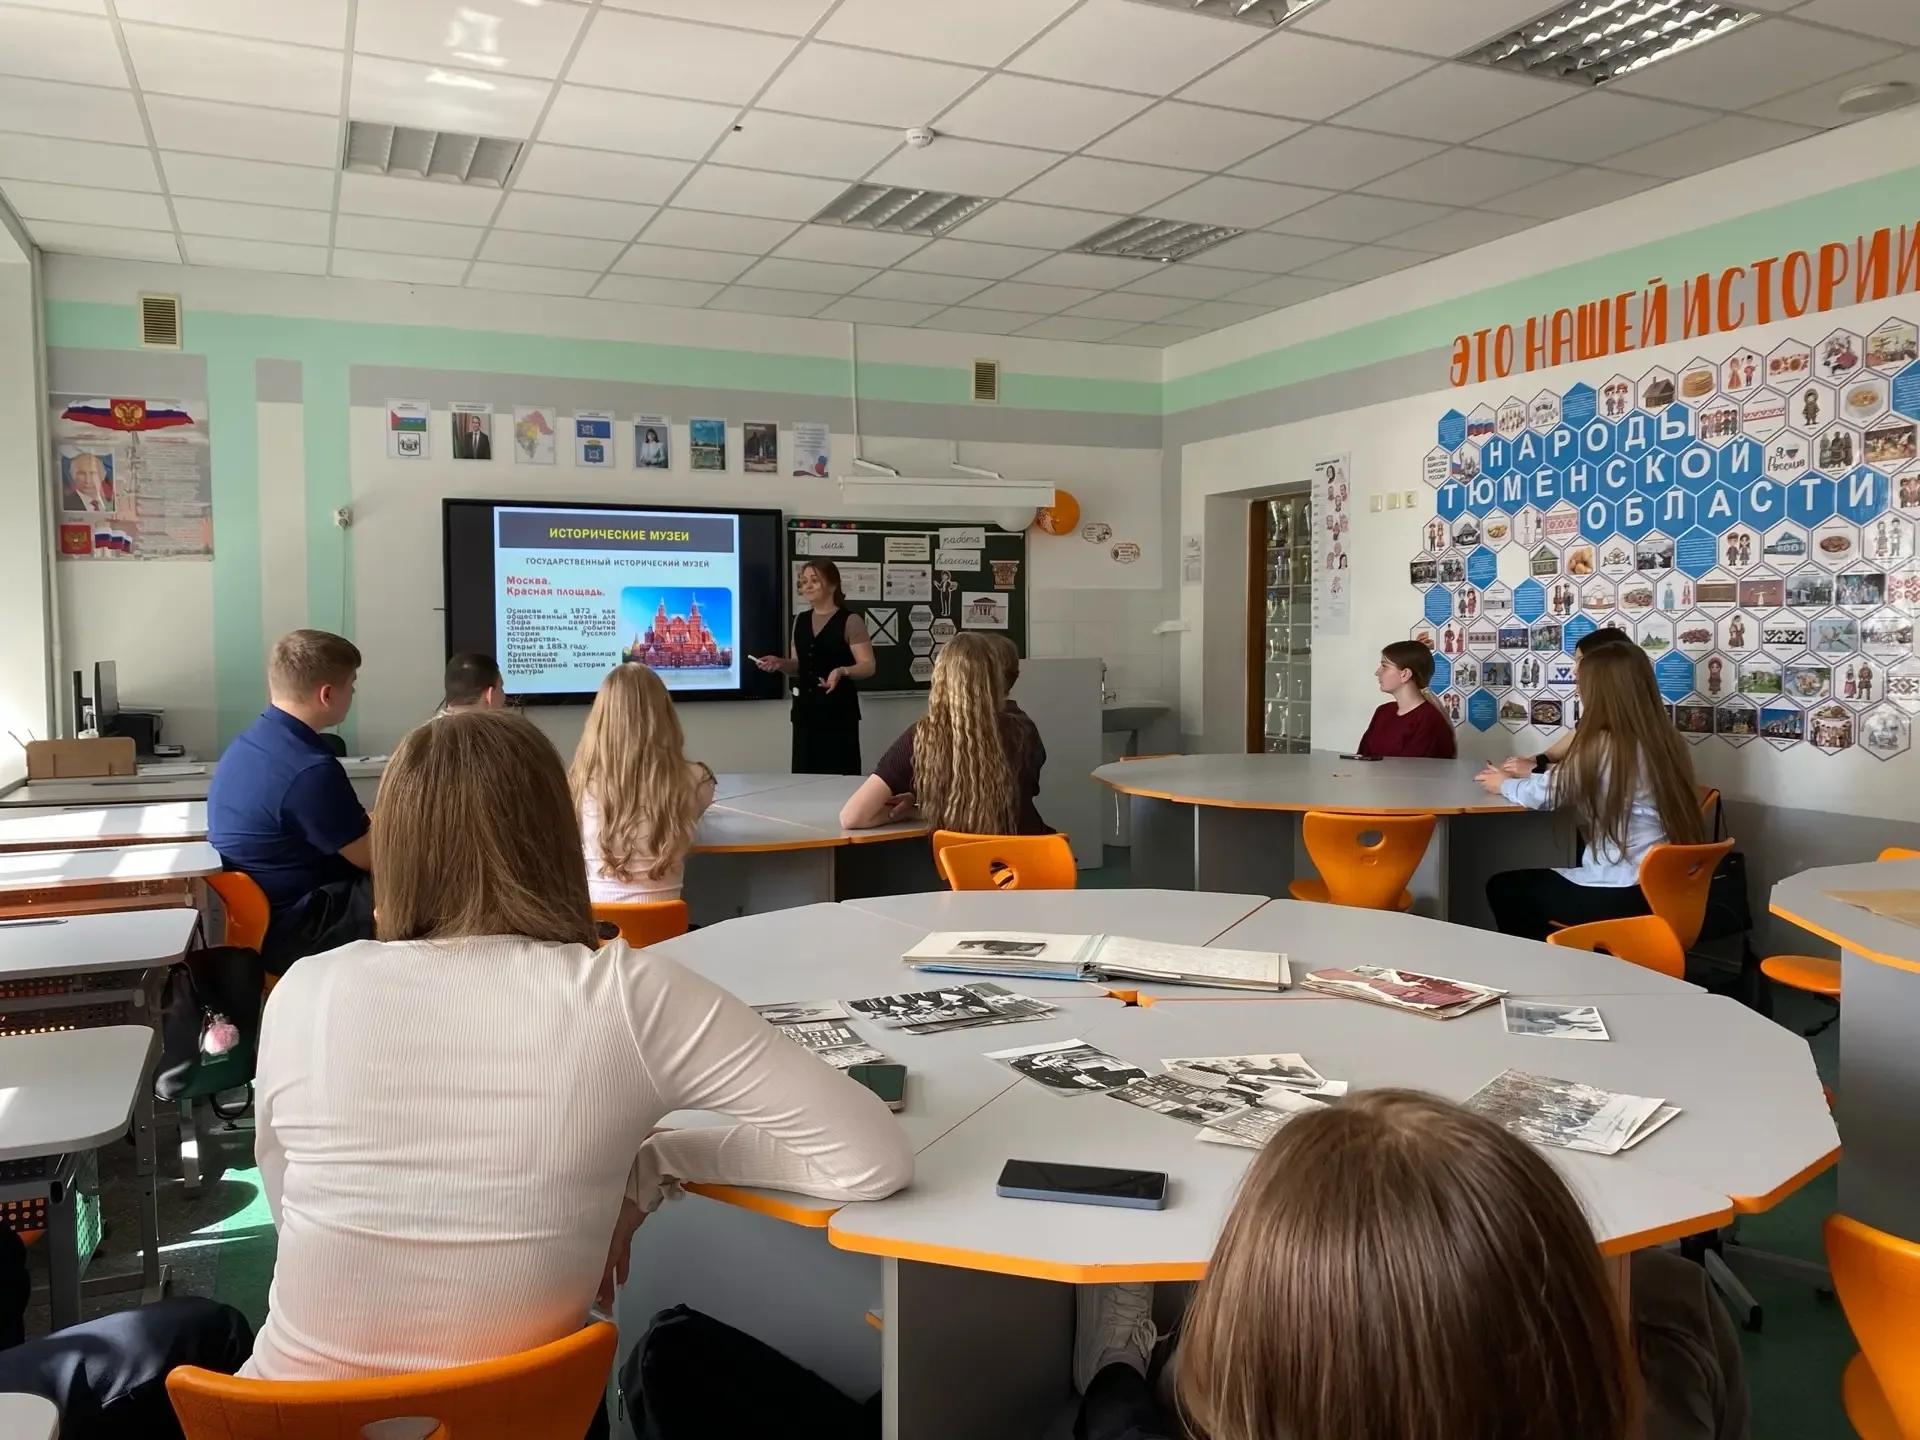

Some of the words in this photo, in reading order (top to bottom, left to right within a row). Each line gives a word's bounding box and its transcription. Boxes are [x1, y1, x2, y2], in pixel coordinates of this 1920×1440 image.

[1450, 324, 1514, 388] ЭТО
[1525, 277, 1668, 372] НАШЕЙ
[1684, 220, 1920, 340] ИСТОРИИ
[1489, 408, 1696, 468] НАРОДЫ
[1775, 446, 1786, 459] Я
[1767, 456, 1805, 471] Россию
[1443, 435, 1750, 509] ТЮМЕНСКОЙ
[1586, 472, 1874, 530] ОБЛАСТИ
[549, 527, 646, 540] ИСТОРИЧЕСКИЕ
[650, 531, 690, 541] МУЗЕИ
[941, 531, 980, 549] работа
[820, 541, 845, 549] мая
[525, 557, 612, 567] ГОСУДАРСТВЕННЫЙ
[613, 559, 680, 568] ИСТОРИЧЕСКИЙ
[682, 560, 710, 568] МУЗЕЙ
[506, 576, 551, 585] Москва.
[506, 587, 553, 597] Красная
[556, 588, 606, 597] площадь.
[506, 607, 542, 615] Основан
[506, 613, 568, 621] общественный
[573, 613, 598, 621] музей
[507, 651, 558, 659] Крупнейшее
